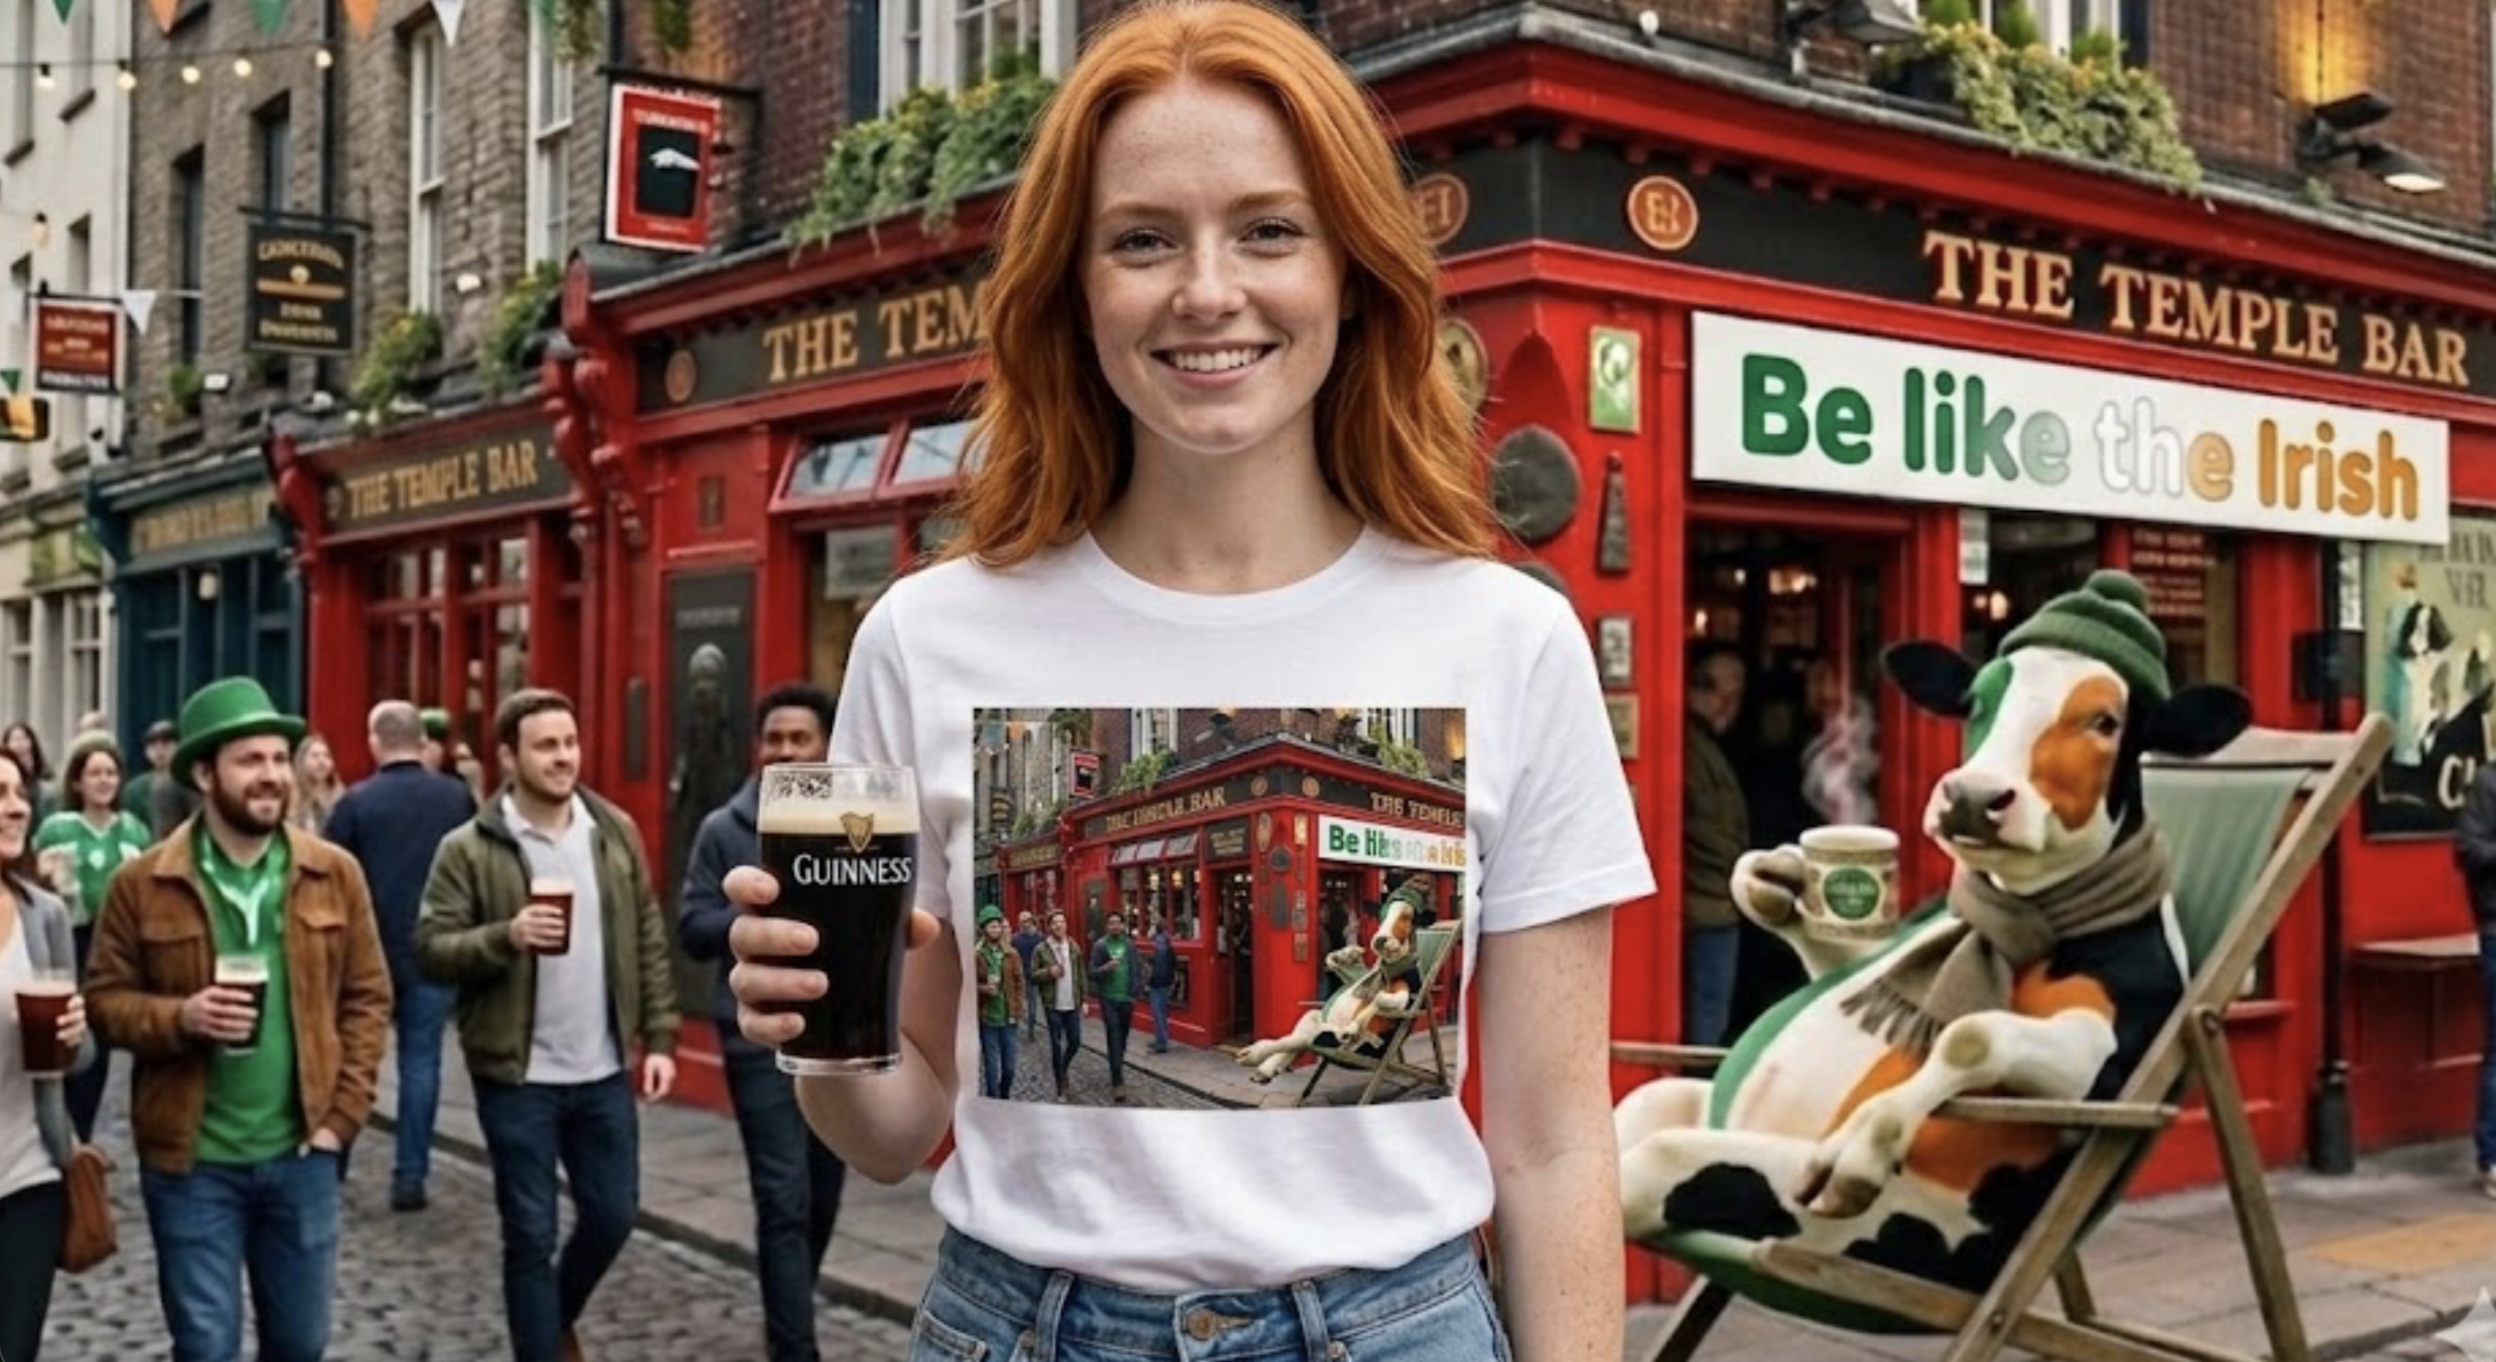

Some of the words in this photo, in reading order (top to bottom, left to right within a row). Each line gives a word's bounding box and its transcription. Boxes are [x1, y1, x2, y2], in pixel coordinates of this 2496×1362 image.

[763, 310, 859, 384] THE
[1923, 230, 2075, 319] THE
[2100, 264, 2339, 364] TEMPLE
[2362, 313, 2469, 387] BAR
[1741, 353, 1874, 465] Be
[1904, 366, 2072, 487] like
[2094, 396, 2236, 502] the
[2258, 418, 2419, 522] Irish
[346, 471, 391, 520] THE
[392, 450, 481, 511] TEMPLE
[486, 439, 538, 494] BAR
[792, 853, 913, 886] GUINNESS
[1329, 823, 1360, 854] Be
